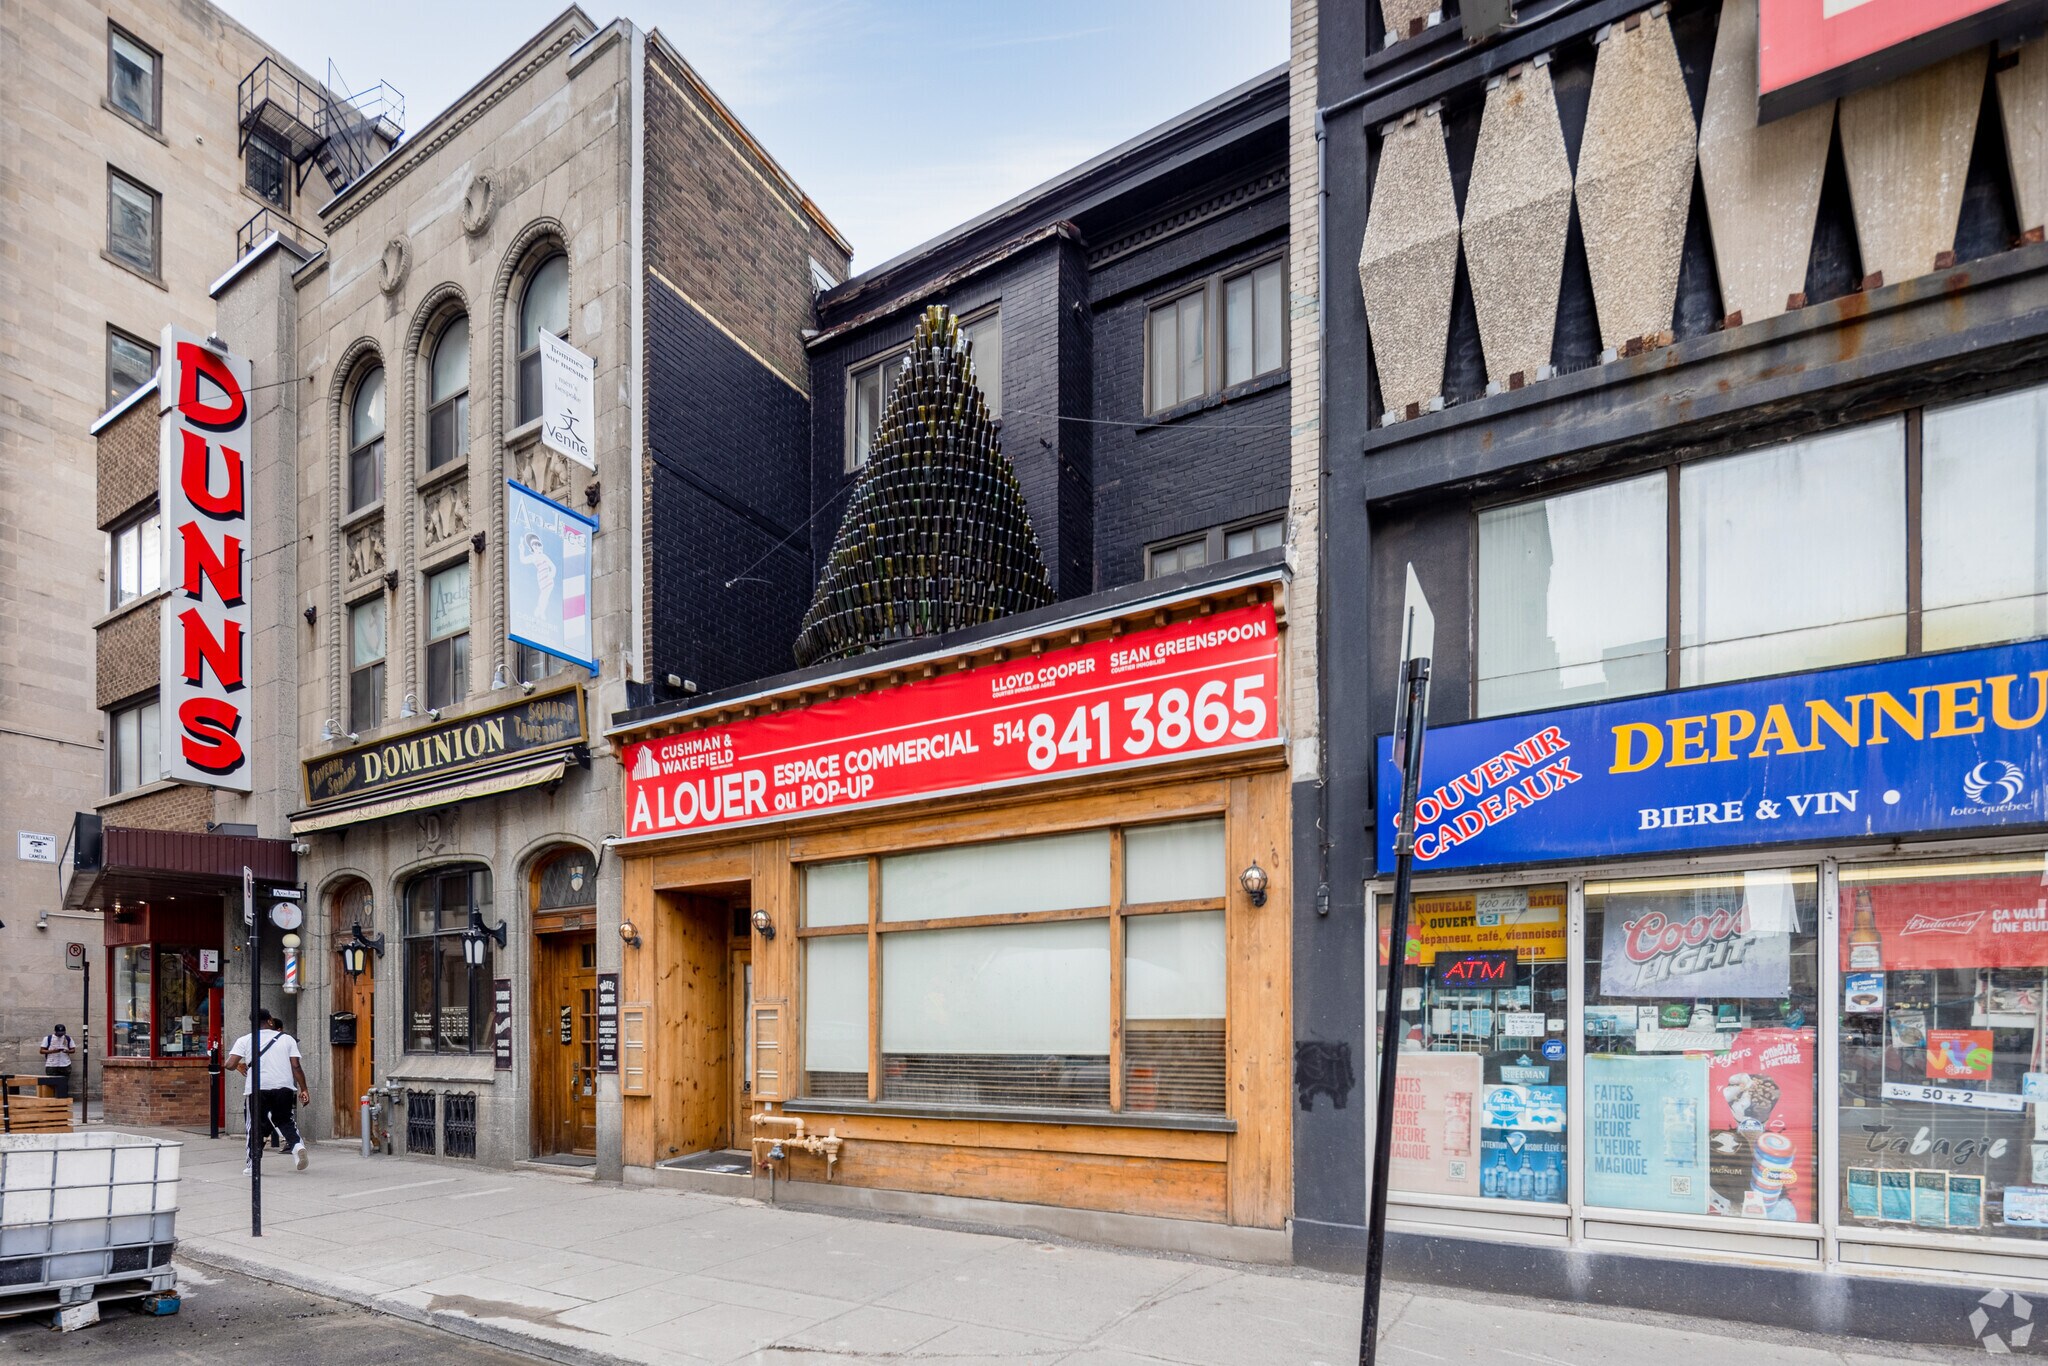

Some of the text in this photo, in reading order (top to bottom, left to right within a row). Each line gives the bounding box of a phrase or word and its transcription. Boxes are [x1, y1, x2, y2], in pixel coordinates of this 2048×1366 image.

[546, 353, 588, 382] sur mesure
[552, 344, 583, 370] hommes
[546, 421, 588, 456] Venne
[177, 341, 247, 775] DUNNS
[992, 620, 1267, 692] LLOYD COOPER SEAN GREENSPOON
[528, 702, 574, 721] SQUARE
[993, 674, 1267, 770] 514 841 3865
[1608, 671, 2048, 774] DEPANNEU
[513, 715, 567, 743] TAVERNE
[361, 717, 505, 784] DOMINION
[661, 734, 733, 760] CUSHMAN &
[774, 730, 979, 787] ESPACE COMMERCIAL
[662, 749, 734, 773] WAKEFIELD
[312, 759, 344, 793] TAVERNE
[328, 762, 356, 795] SQUARE
[631, 770, 768, 832] À LOUER
[774, 775, 874, 811] ou POP-UP
[1414, 756, 1582, 861] CADEAUX
[1638, 790, 1859, 830] BIERE & VIN
[1418, 900, 1472, 914] NOUVELLE
[1992, 908, 2046, 921] ÇA VAUT
[1430, 916, 1476, 928] OUVERT
[1909, 917, 1976, 930] Budweiser
[1992, 921, 2019, 933] UNE
[1477, 930, 1502, 942] café,
[1623, 907, 1751, 962] Coors
[1446, 961, 1506, 979] ATM
[1634, 937, 1756, 991] LIGHT
[1546, 1045, 1562, 1053] ADT
[1394, 1077, 1421, 1093] AITES
[1504, 1070, 1546, 1079] SLEEMAN
[1393, 1094, 1427, 1110] HAQUE
[1594, 1085, 1634, 1101] FAITES
[1922, 1088, 1943, 1101] 50
[1963, 1092, 1974, 1103] 2
[1394, 1110, 1419, 1126] EURE
[1594, 1103, 1641, 1120] CHAQUE
[1594, 1121, 1632, 1137] HEURE
[1525, 1143, 1544, 1152] RISQUE
[1594, 1139, 1642, 1156] L'HEURE
[1862, 1124, 2008, 1165] Tabagie
[1594, 1157, 1648, 1175] MAGIQUE
